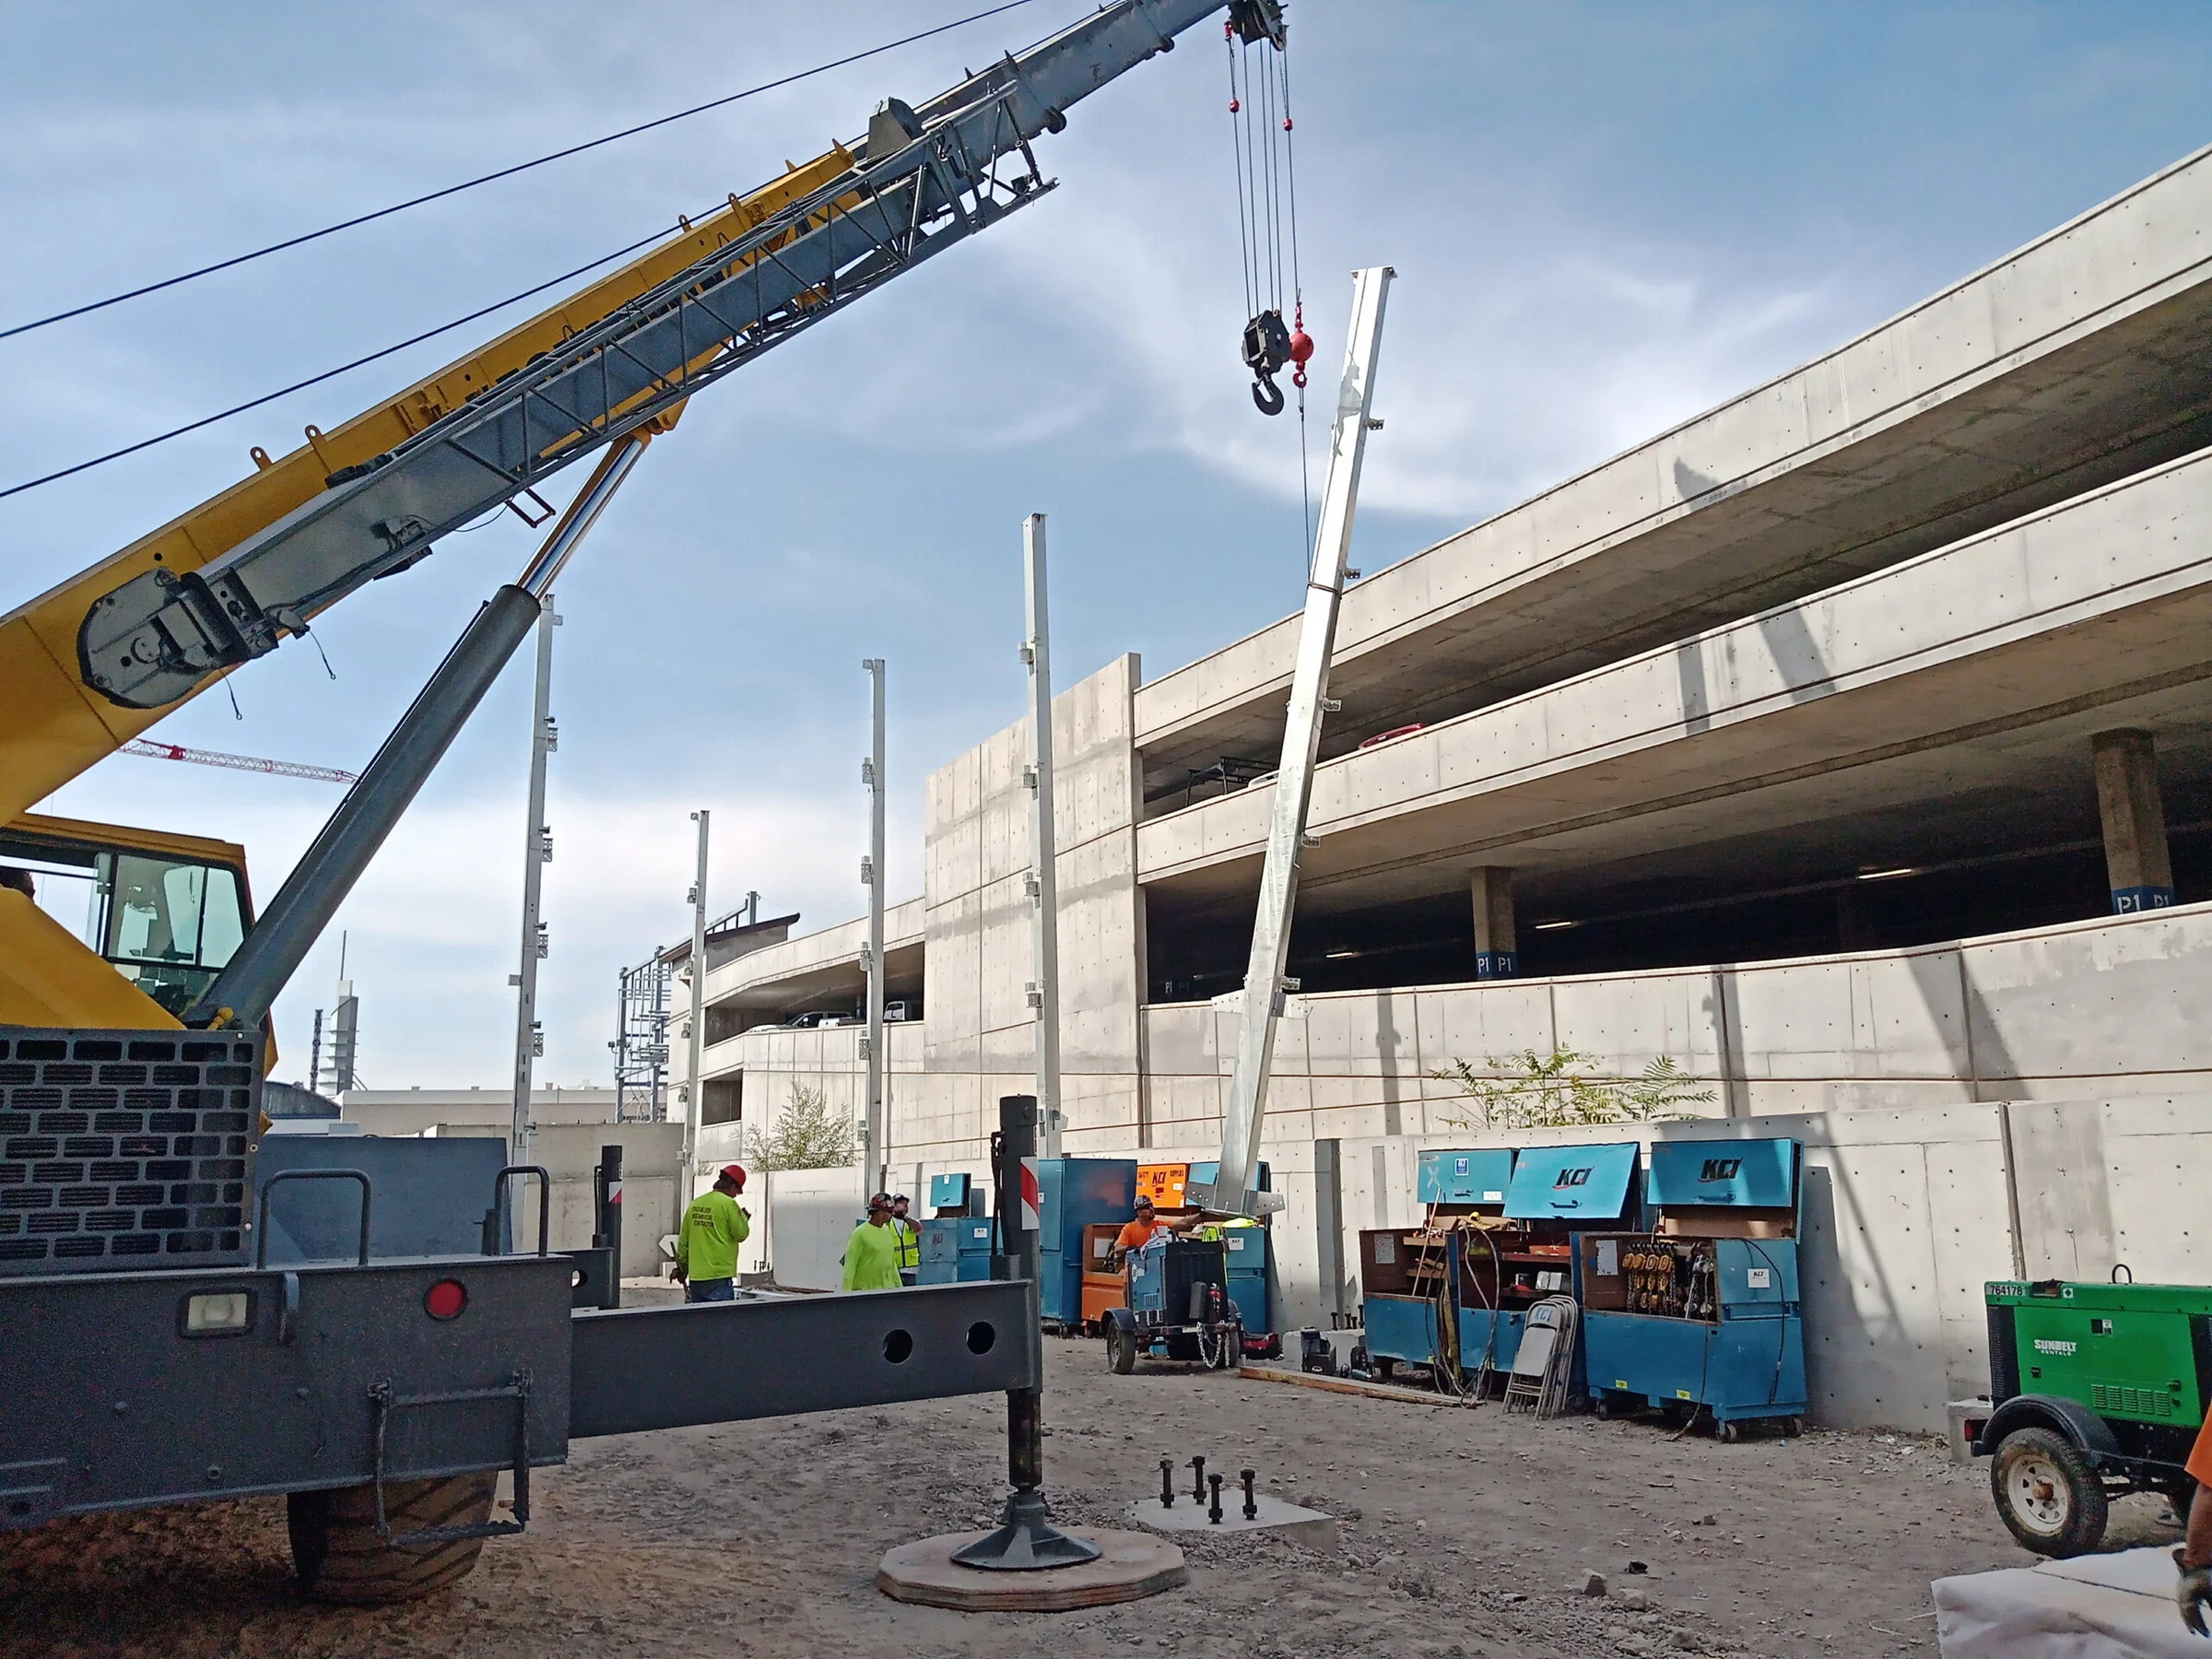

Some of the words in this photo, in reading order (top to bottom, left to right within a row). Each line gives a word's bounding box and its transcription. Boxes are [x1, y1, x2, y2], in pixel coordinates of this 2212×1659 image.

[2117, 894, 2141, 913] P1
[2153, 894, 2170, 908] P1
[1477, 957, 1489, 973] P1
[1498, 957, 1512, 972] P1
[1554, 1166, 1595, 1186] KCI
[1700, 1158, 1744, 1181] KCI
[1990, 1285, 2023, 1296] 764178
[2033, 1339, 2077, 1352] SUNBELT
